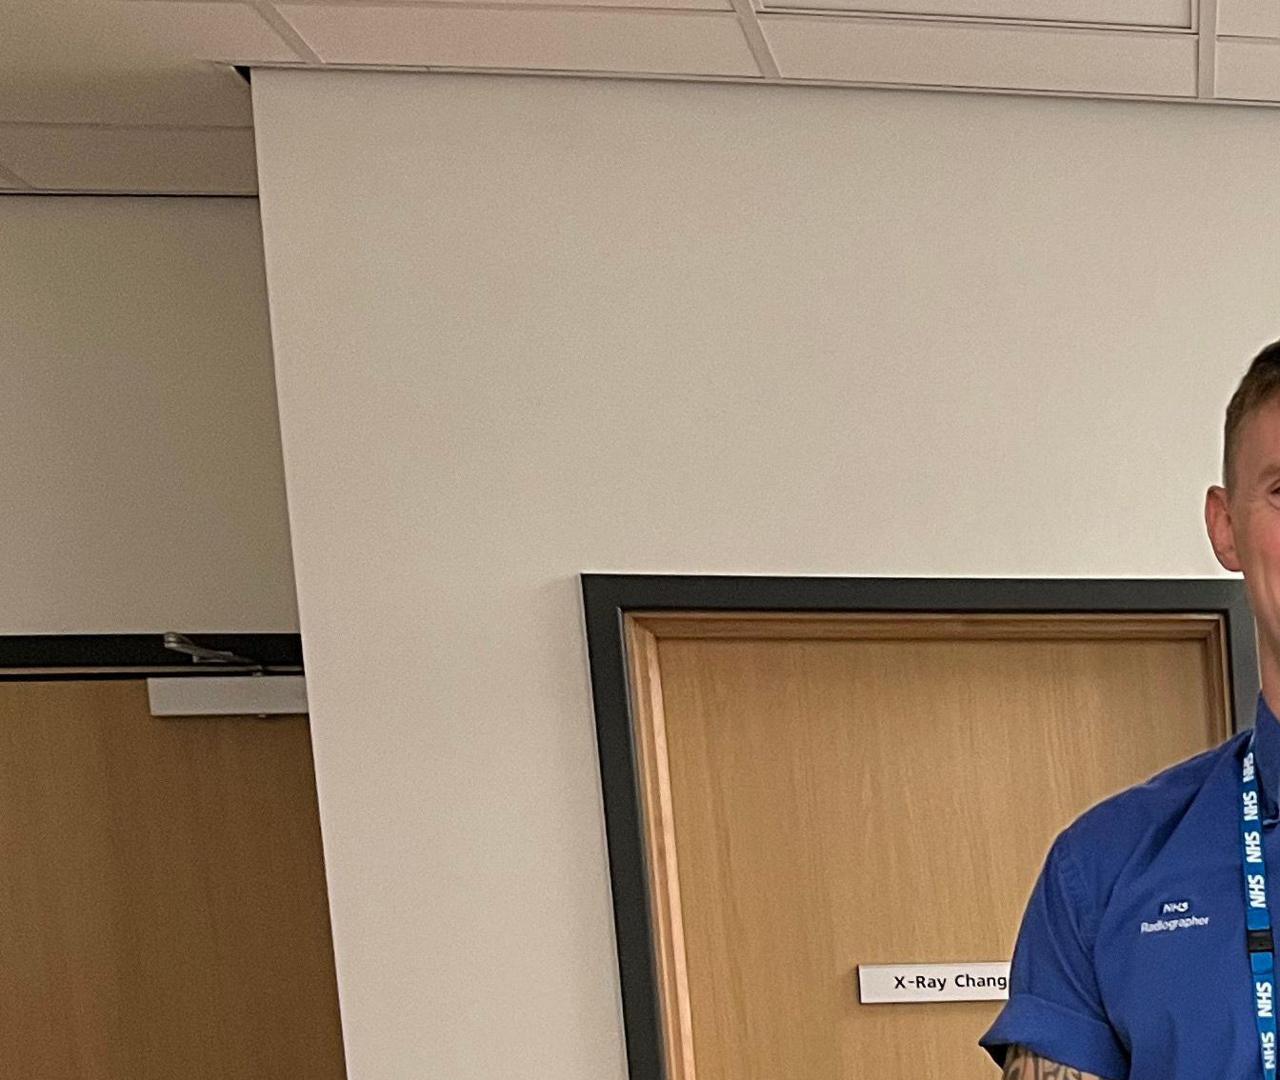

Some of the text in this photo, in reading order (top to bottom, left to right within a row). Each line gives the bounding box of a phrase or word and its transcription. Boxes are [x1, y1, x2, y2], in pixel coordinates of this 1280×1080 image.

[1242, 791, 1259, 821] NHS
[1244, 831, 1263, 863] NHS
[1250, 874, 1266, 908] NHS
[1163, 902, 1189, 914] NHS
[1141, 916, 1209, 933] Radiographer
[894, 974, 1008, 991] X-Ray Chang
[1256, 982, 1275, 1070] NHS NHS
